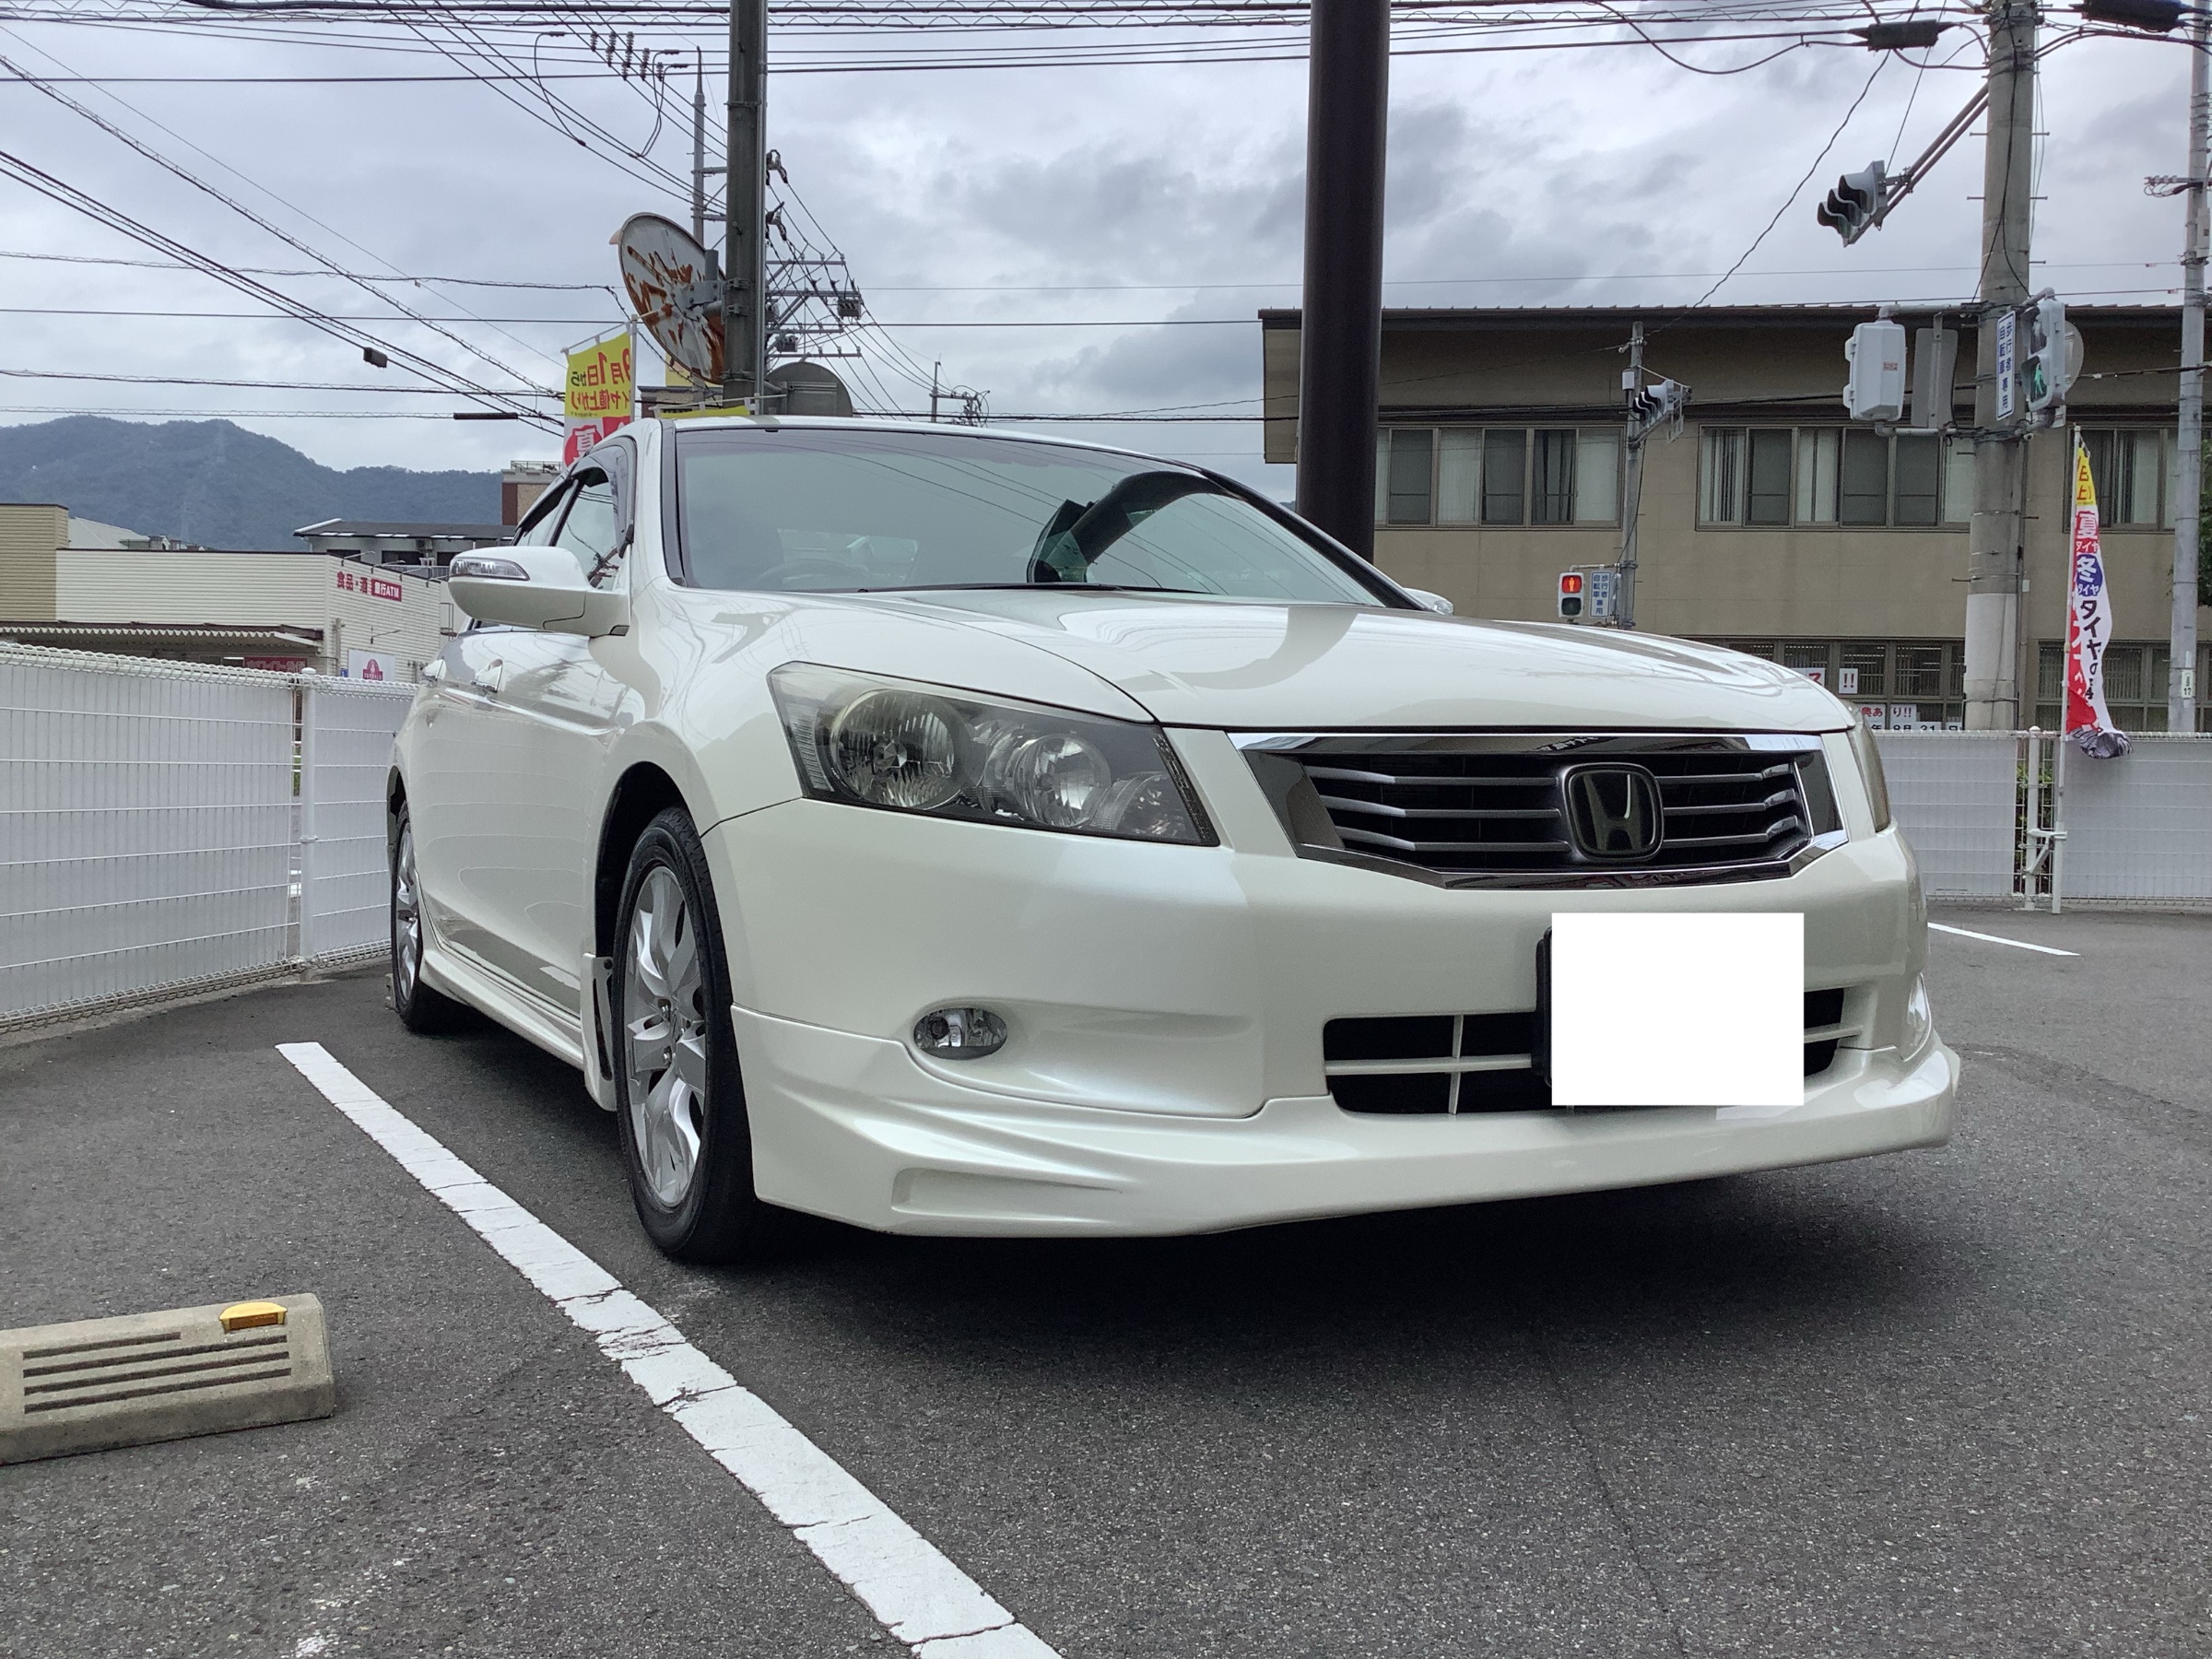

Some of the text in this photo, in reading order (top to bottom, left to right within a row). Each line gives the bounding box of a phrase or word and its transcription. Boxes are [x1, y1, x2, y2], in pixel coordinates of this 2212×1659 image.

[2077, 513, 2099, 540] 夏
[2076, 540, 2100, 553] タイヤ
[2077, 556, 2098, 583] 冬
[2077, 583, 2100, 597] タイヤ
